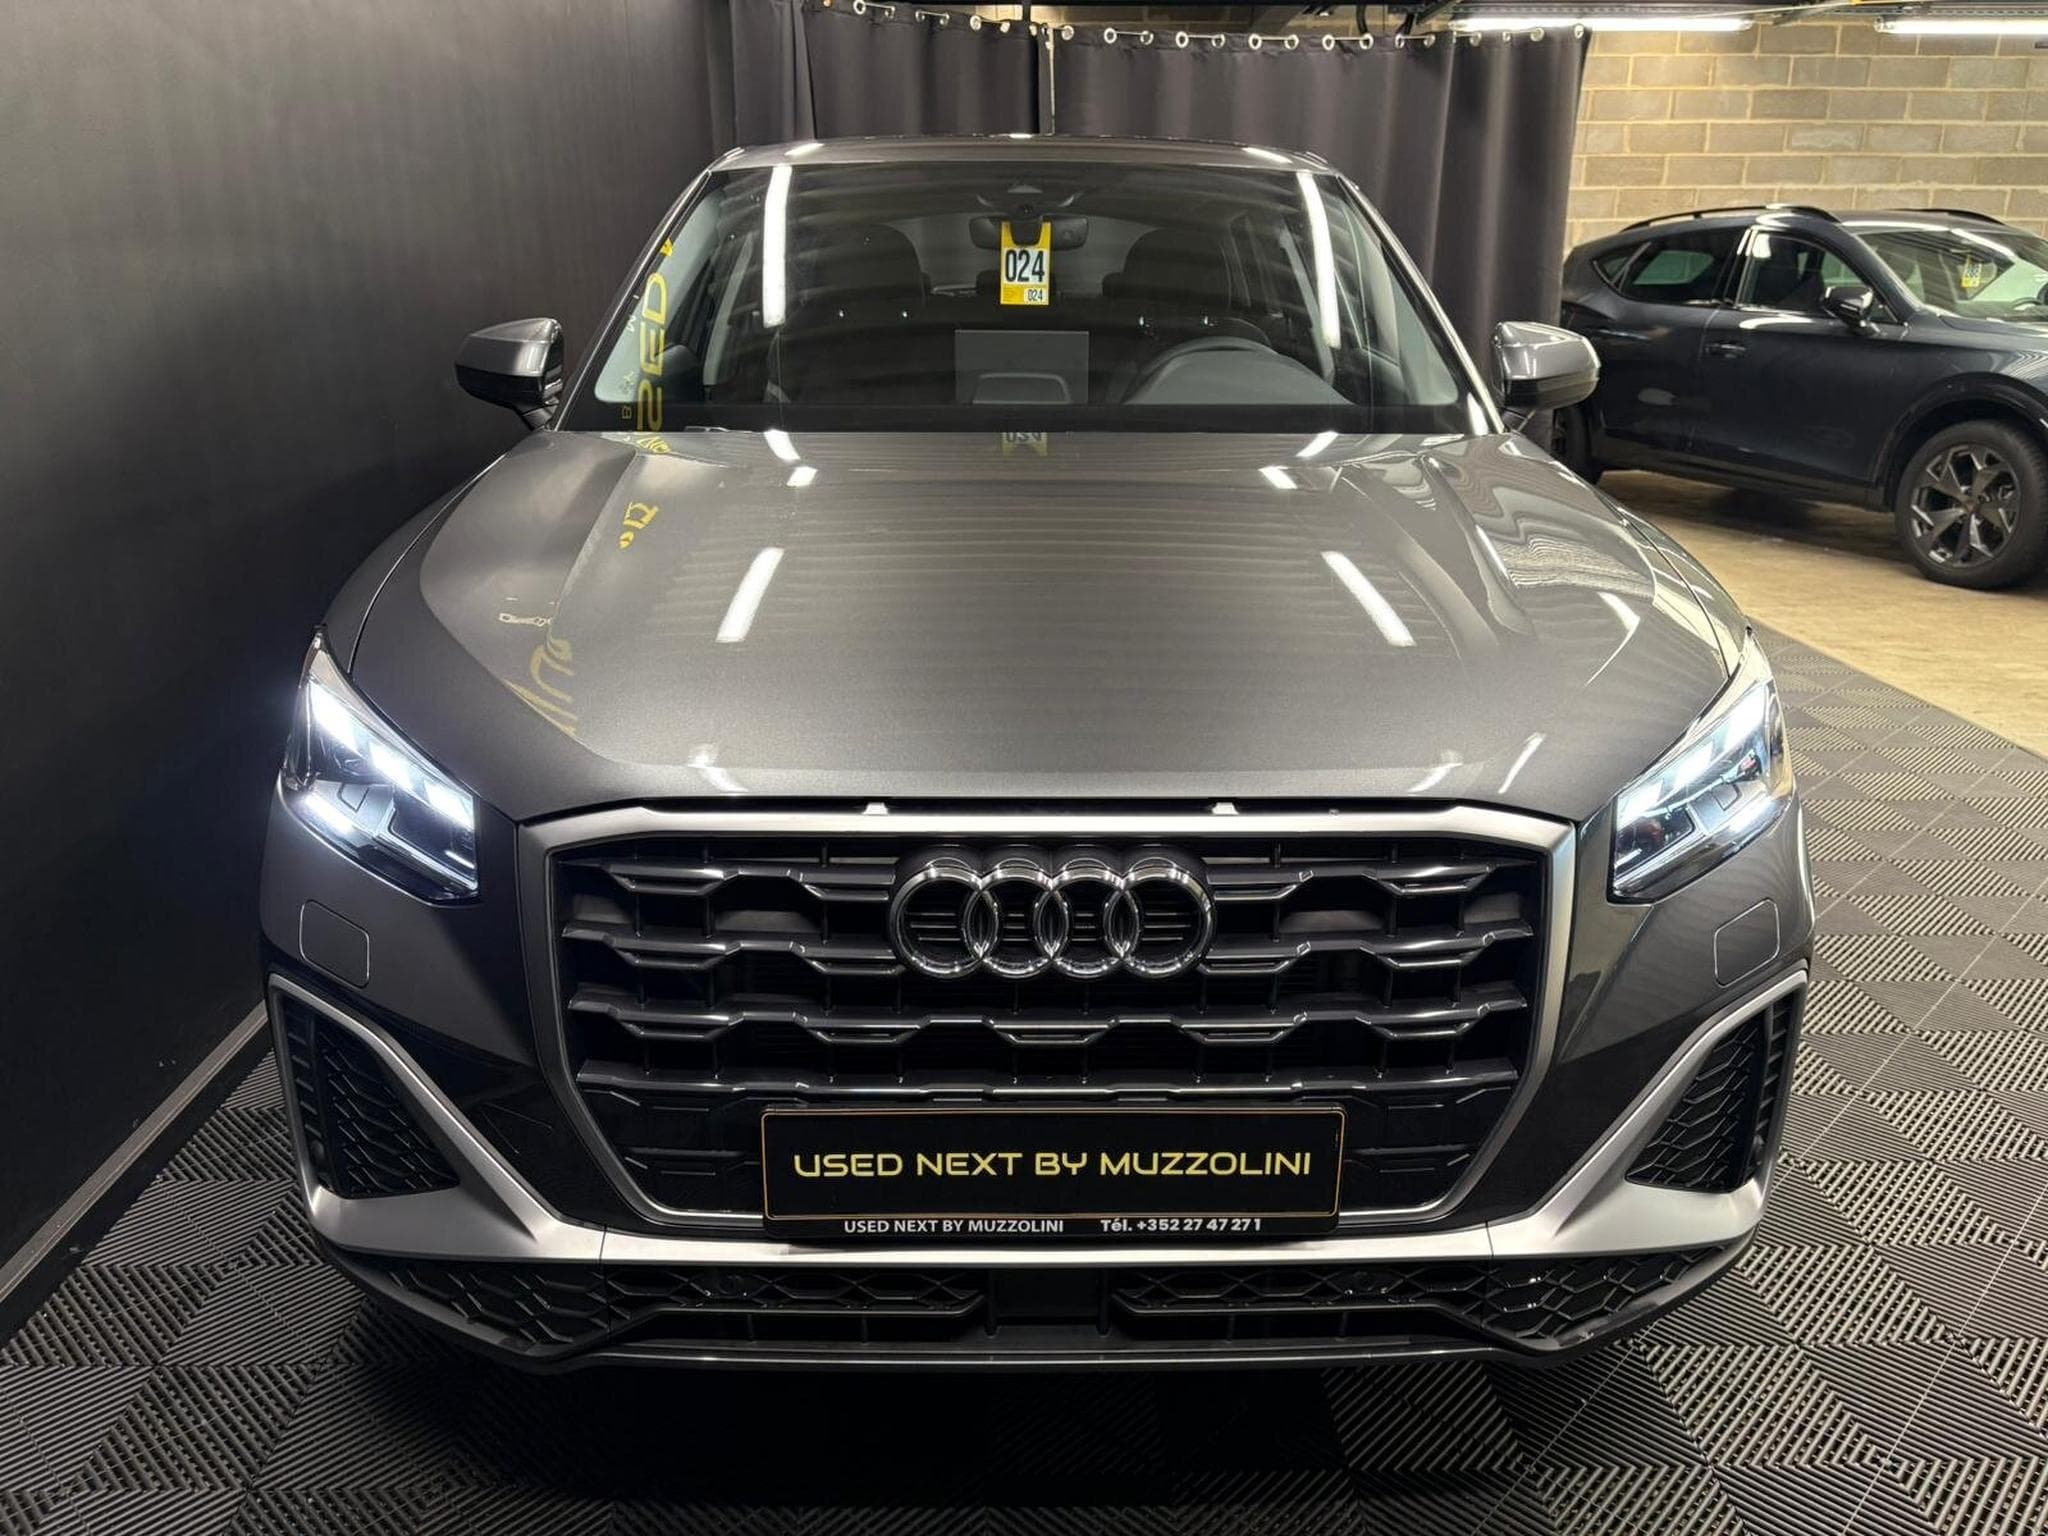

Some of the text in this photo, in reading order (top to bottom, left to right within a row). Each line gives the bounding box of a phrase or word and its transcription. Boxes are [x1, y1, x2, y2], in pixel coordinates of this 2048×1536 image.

[1005, 249, 1045, 282] 024
[1027, 288, 1043, 301] 024
[793, 1151, 1311, 1178] USED NEXT BY MUZZOLINI
[844, 1220, 889, 1233] USED
[894, 1219, 938, 1233] NEXT
[942, 1219, 963, 1233] BY
[968, 1219, 1064, 1233] MUZZOLINI
[1101, 1217, 1133, 1232] Tél.
[1136, 1218, 1179, 1232] +352
[1183, 1218, 1203, 1231] 27
[1206, 1218, 1229, 1231] 47
